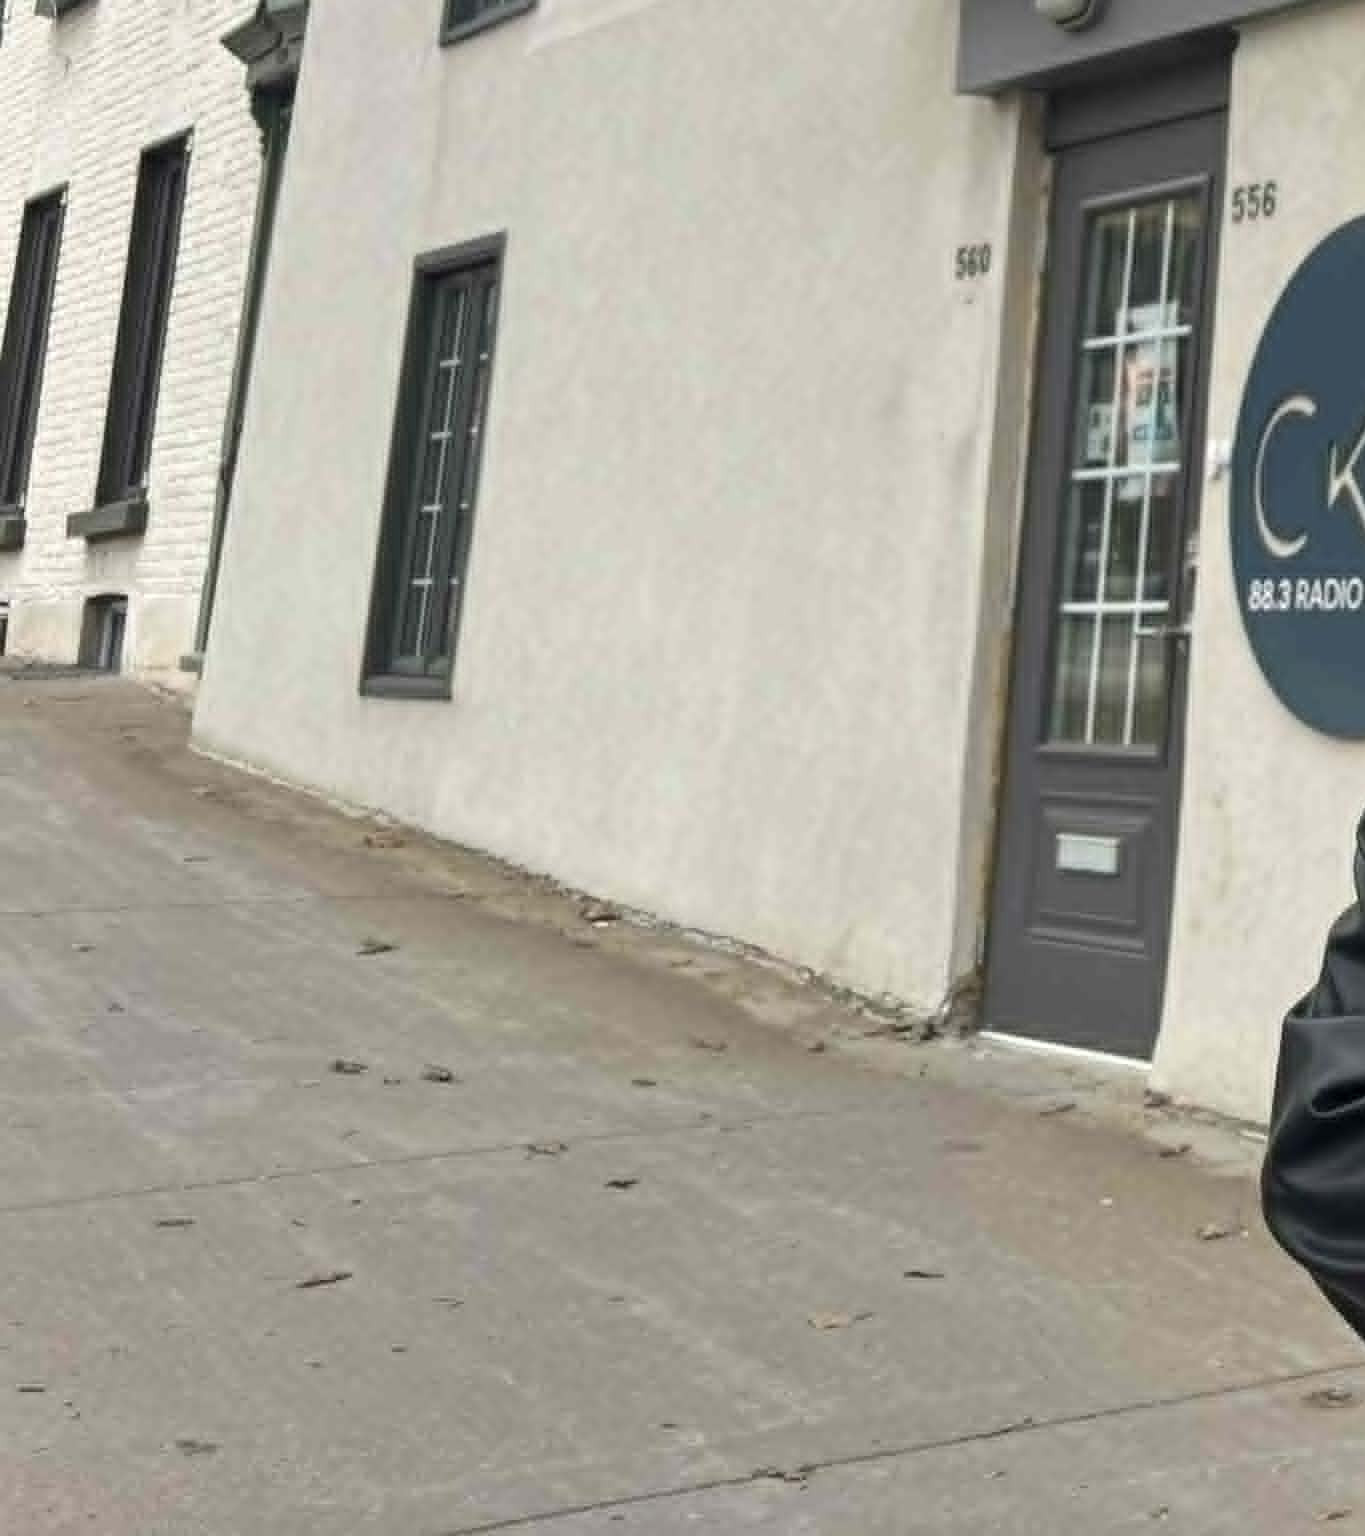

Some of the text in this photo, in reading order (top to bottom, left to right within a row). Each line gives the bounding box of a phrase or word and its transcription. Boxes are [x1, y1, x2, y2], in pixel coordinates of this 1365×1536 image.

[1231, 180, 1277, 223] 556
[955, 243, 991, 280] 560
[1248, 578, 1291, 612] 88.3
[1295, 577, 1363, 611] RADIO
